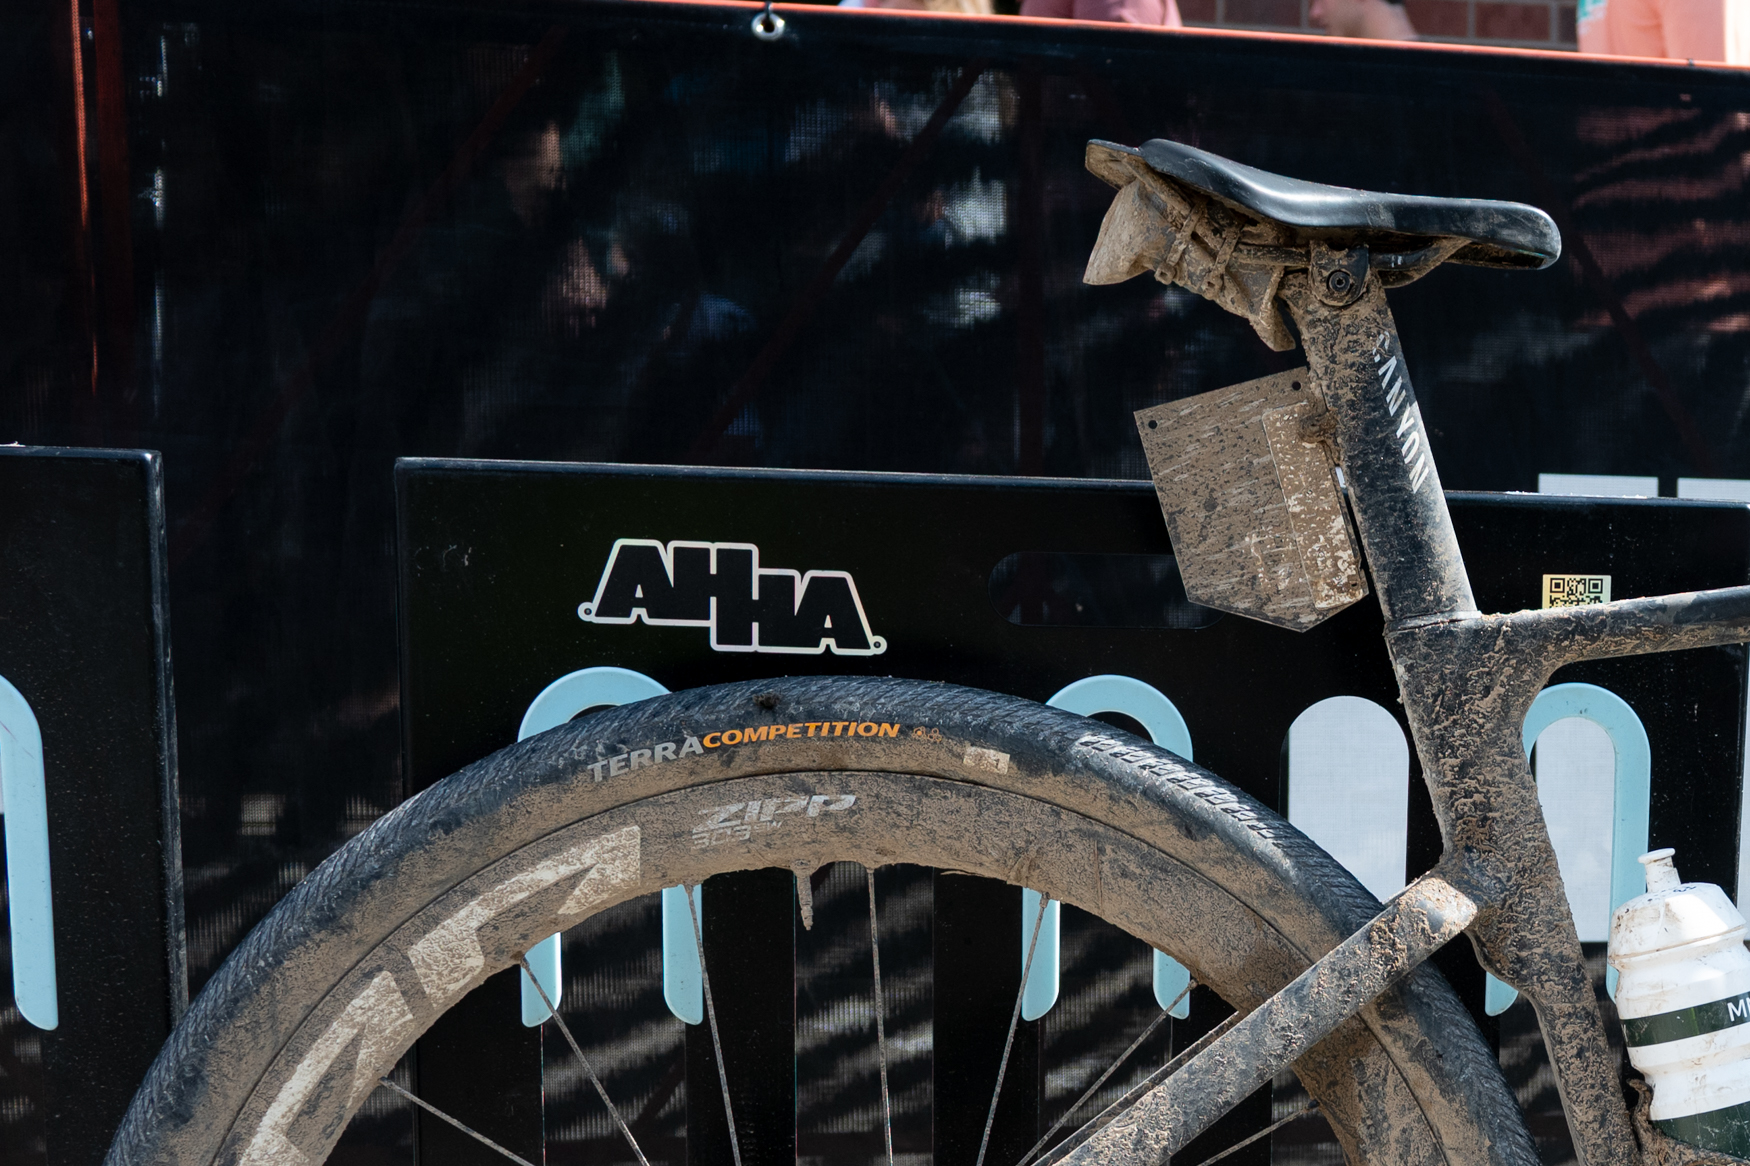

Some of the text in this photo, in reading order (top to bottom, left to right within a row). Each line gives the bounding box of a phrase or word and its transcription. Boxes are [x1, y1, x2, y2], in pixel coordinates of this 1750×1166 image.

[586, 721, 900, 782] TERRA COMPETITION
[698, 795, 858, 829] ZIPP
